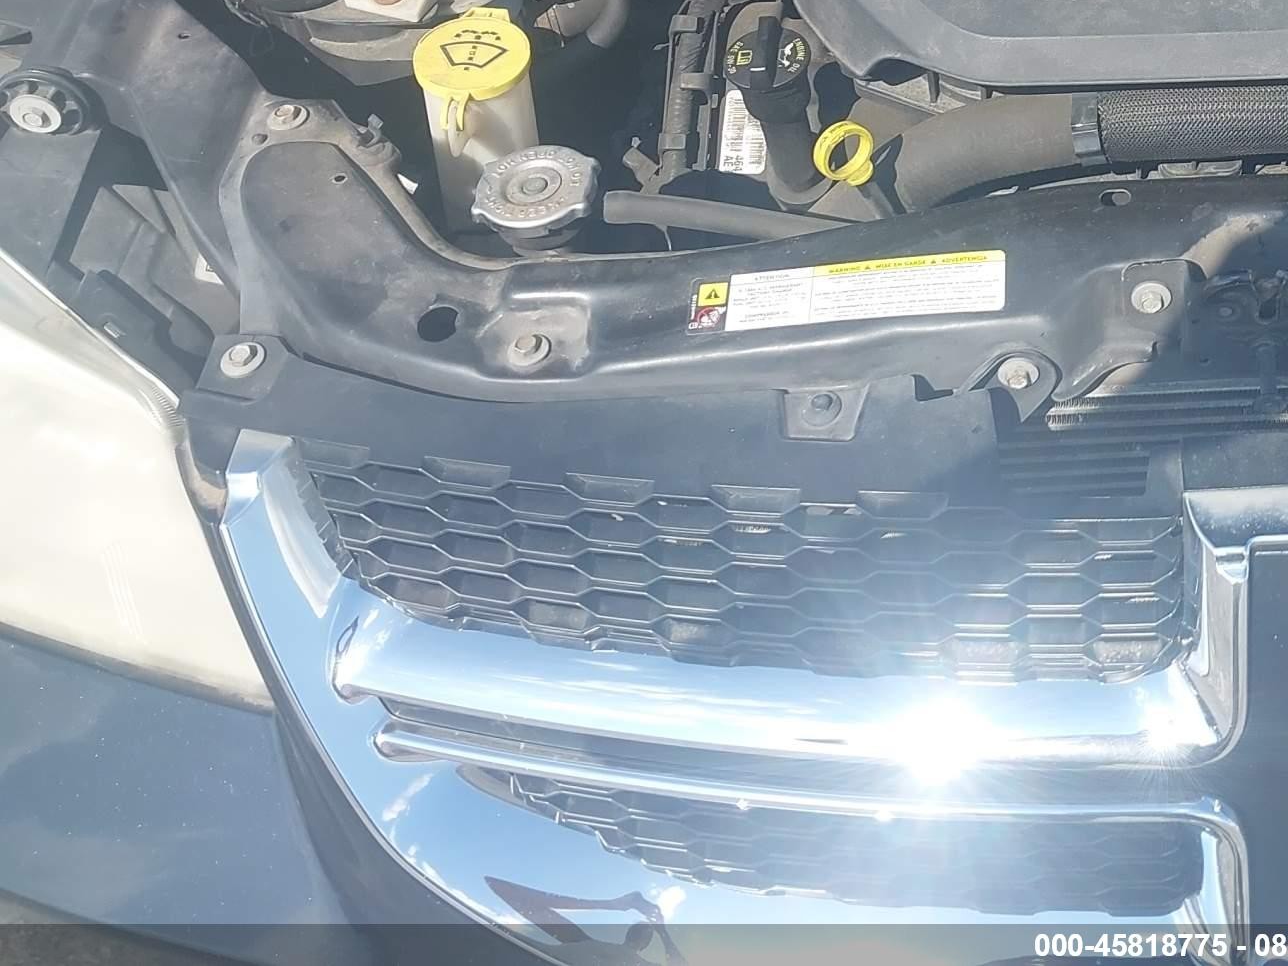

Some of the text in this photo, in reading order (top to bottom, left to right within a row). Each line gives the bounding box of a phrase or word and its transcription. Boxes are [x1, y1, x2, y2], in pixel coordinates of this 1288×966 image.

[730, 41, 744, 53] SAE
[787, 38, 806, 73] ENGINE OIL
[519, 151, 557, 162] OPEN
[941, 256, 988, 264] ADVERTENCIA
